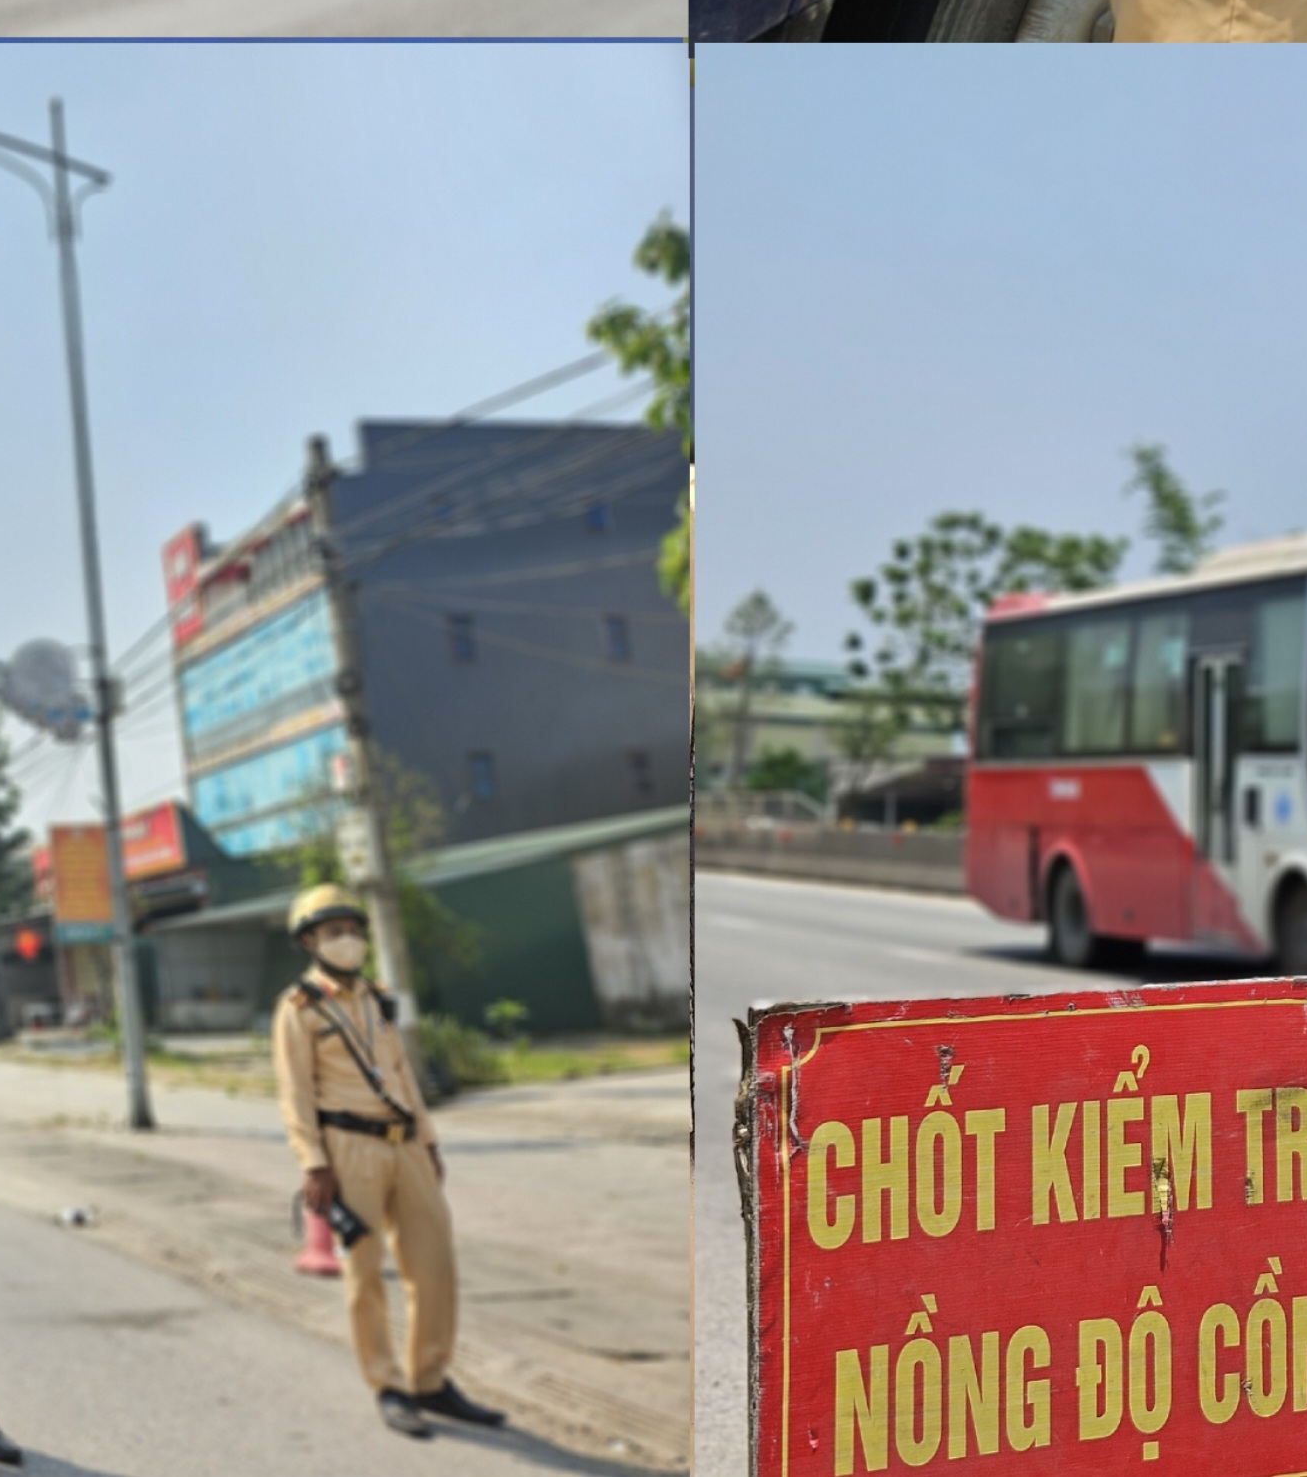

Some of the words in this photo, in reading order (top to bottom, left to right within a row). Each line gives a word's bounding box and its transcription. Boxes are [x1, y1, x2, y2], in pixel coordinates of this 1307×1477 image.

[806, 1064, 1006, 1250] CHỐT
[1031, 1044, 1213, 1226] KIỂM
[834, 1294, 1053, 1477] NỒNG
[1075, 1285, 1173, 1461] ĐỘ
